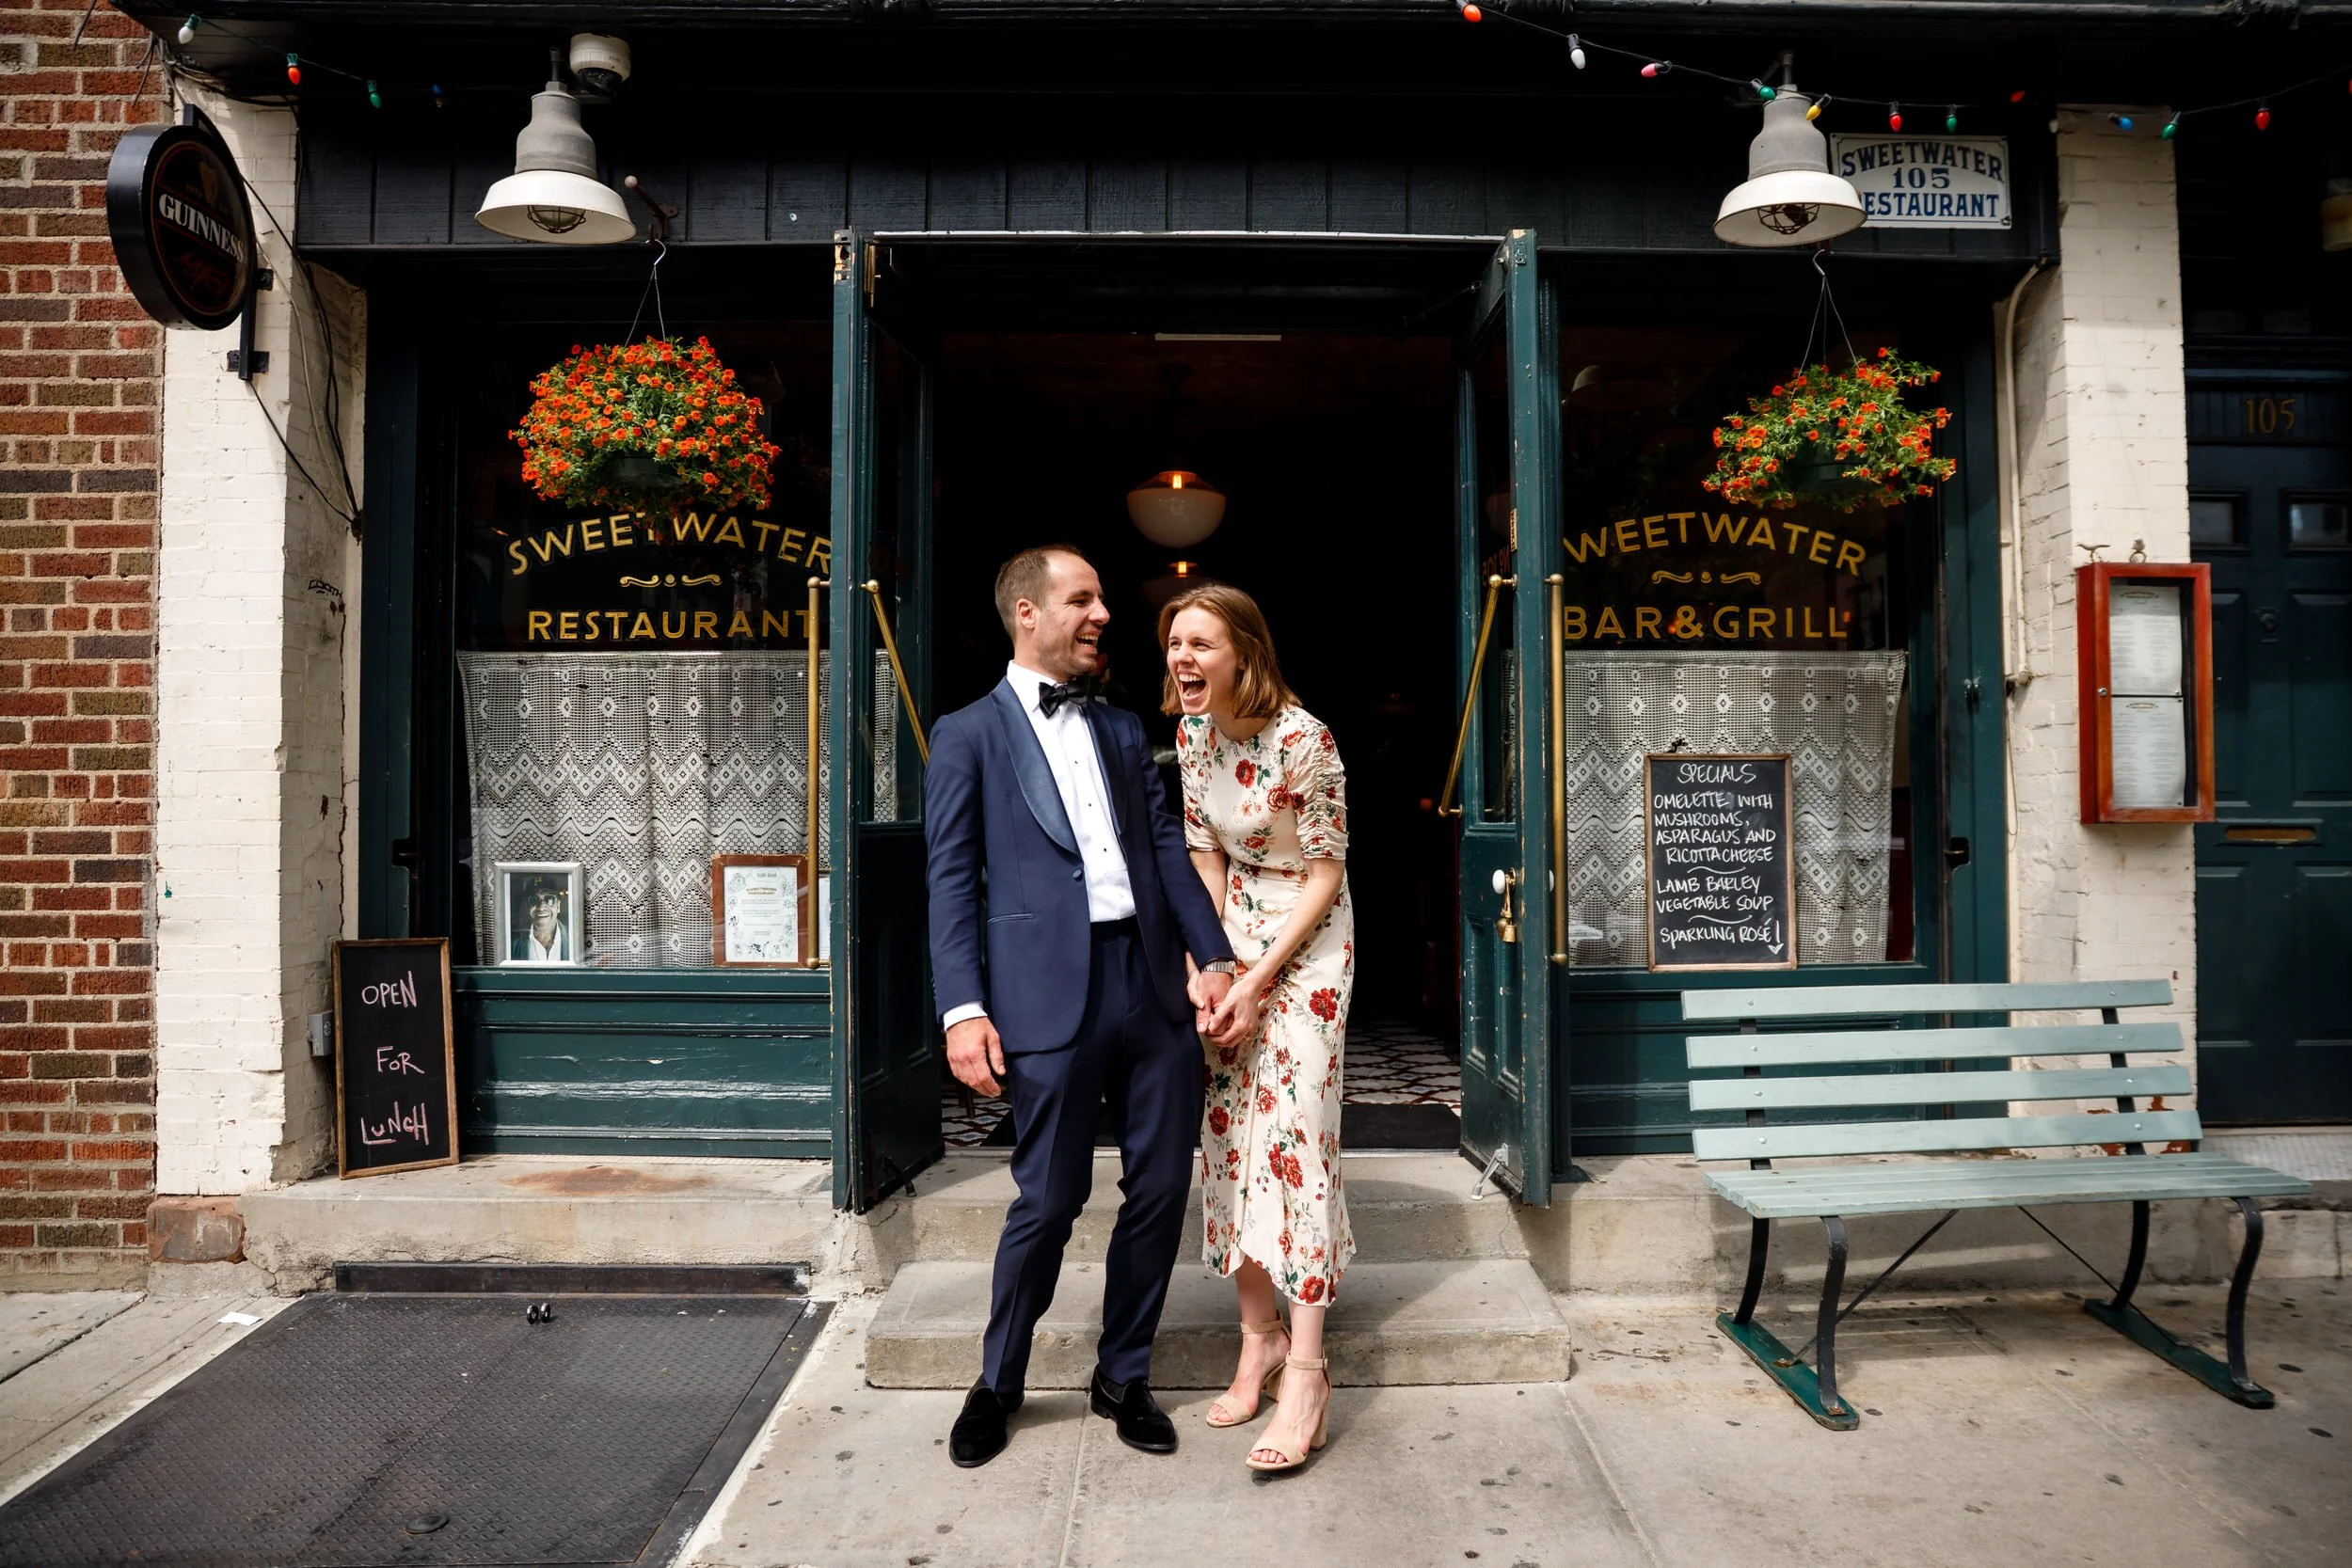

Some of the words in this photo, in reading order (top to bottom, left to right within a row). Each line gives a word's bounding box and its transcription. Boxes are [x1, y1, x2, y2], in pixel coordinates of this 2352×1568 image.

[1841, 141, 2005, 183] SWEETWATER
[1893, 167, 1950, 189] 105
[1863, 191, 2000, 217] ESTAURANT
[159, 193, 244, 262] GUINNESS
[2245, 398, 2296, 435] 105
[1563, 512, 1867, 577] WEETWATER
[1677, 763, 1757, 784] SPECIALS
[1654, 791, 1729, 810] OMELETTE
[1738, 793, 1773, 810] WITH
[1656, 829, 1740, 846] ASPARAGUS
[1745, 829, 1776, 844] AND
[1657, 878, 1701, 895] LAMB
[1706, 876, 1761, 895] BARLEY
[1656, 895, 1731, 914] VEGETABLE
[1736, 895, 1774, 911] SOUP
[361, 970, 418, 1008] OPEN
